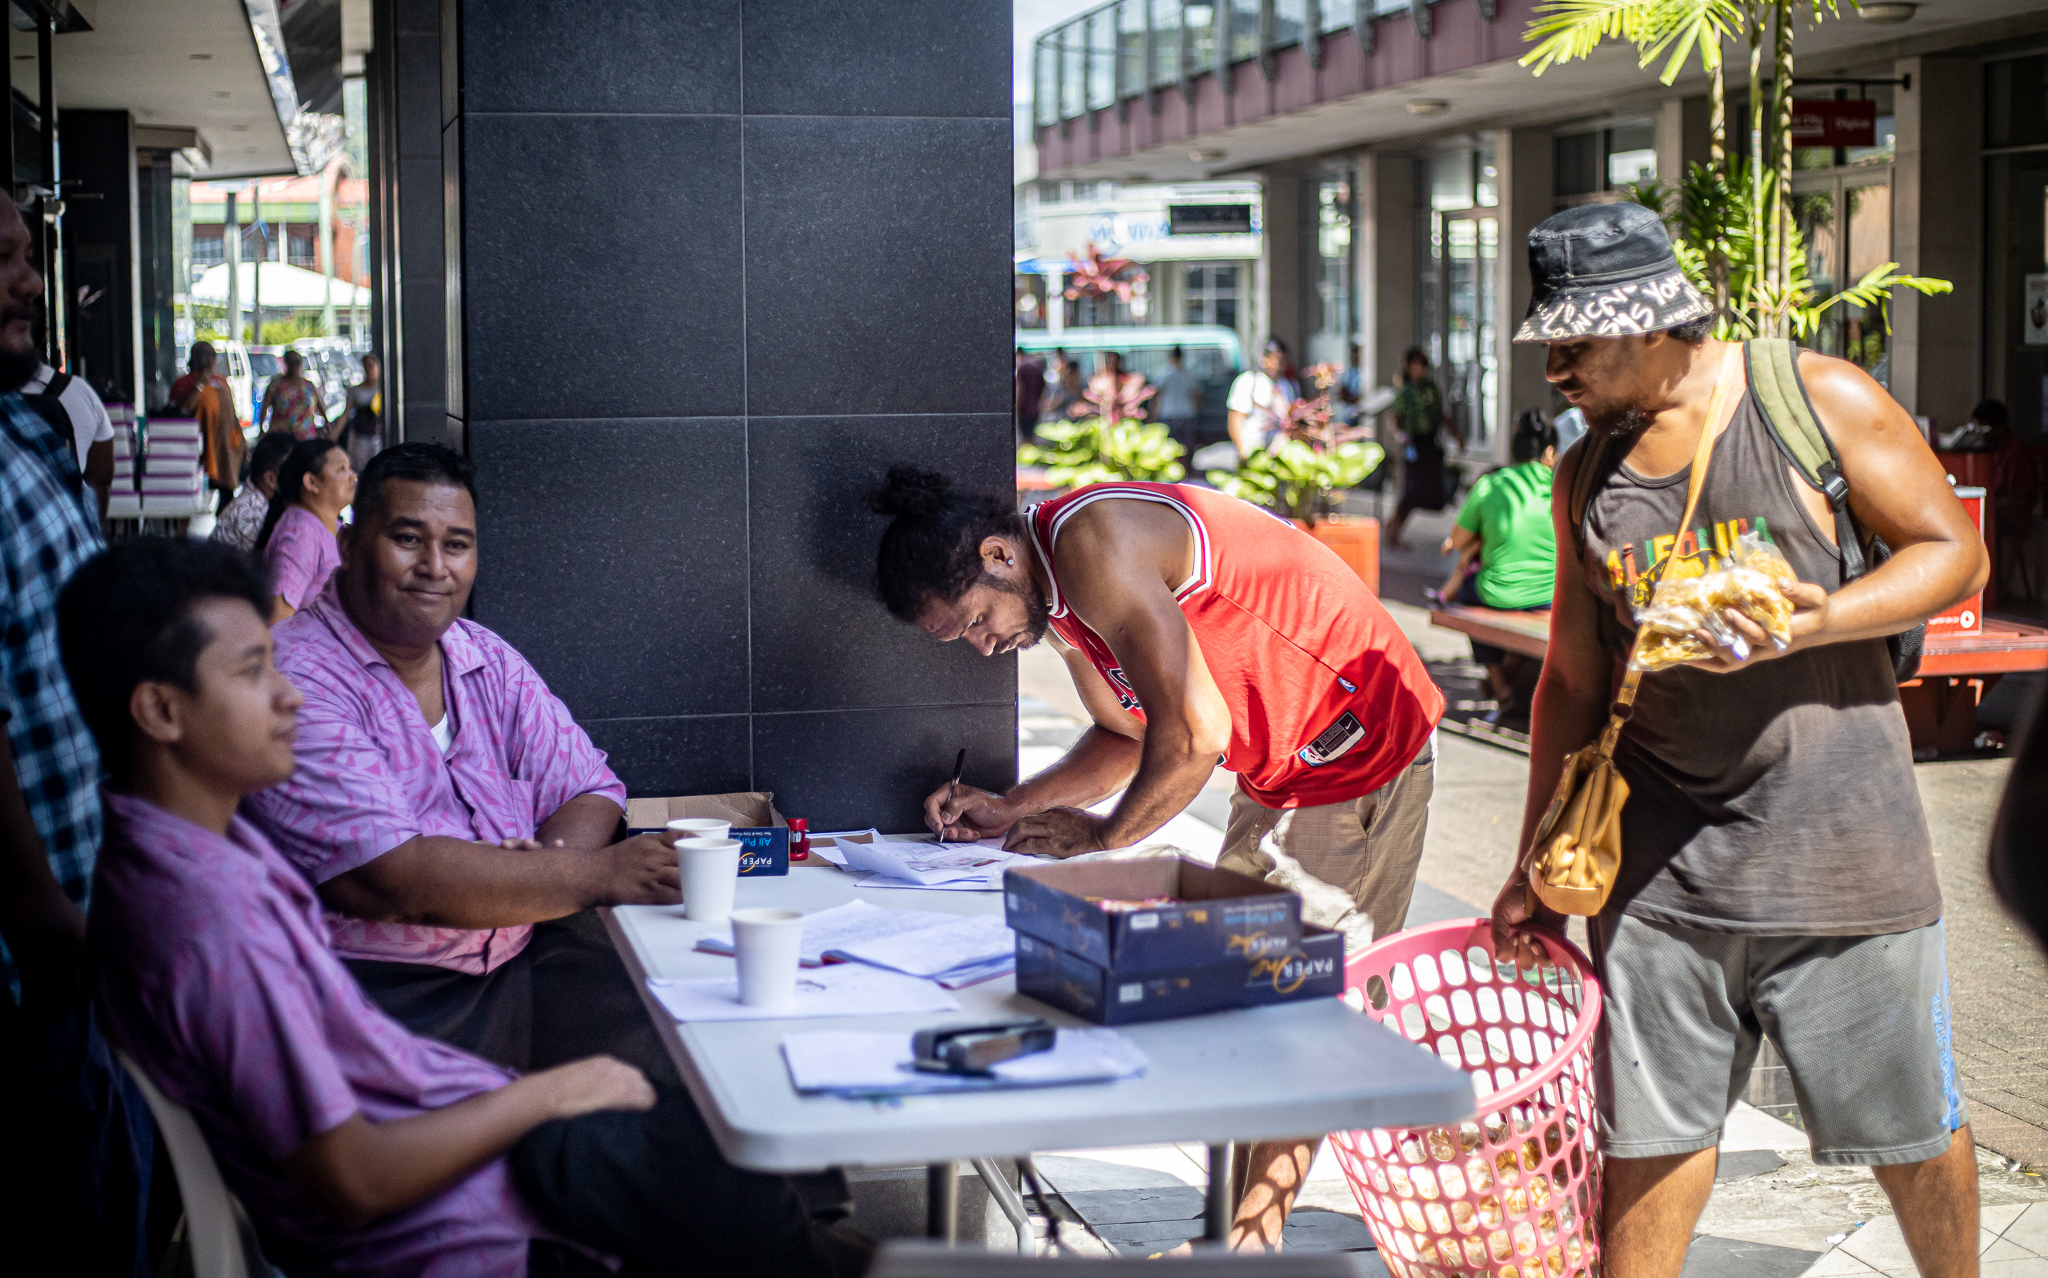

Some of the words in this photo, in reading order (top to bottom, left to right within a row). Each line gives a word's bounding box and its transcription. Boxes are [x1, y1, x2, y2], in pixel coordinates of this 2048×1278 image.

[759, 837, 772, 847] All
[742, 857, 772, 865] PAPER
[1283, 957, 1333, 978] PAPER
